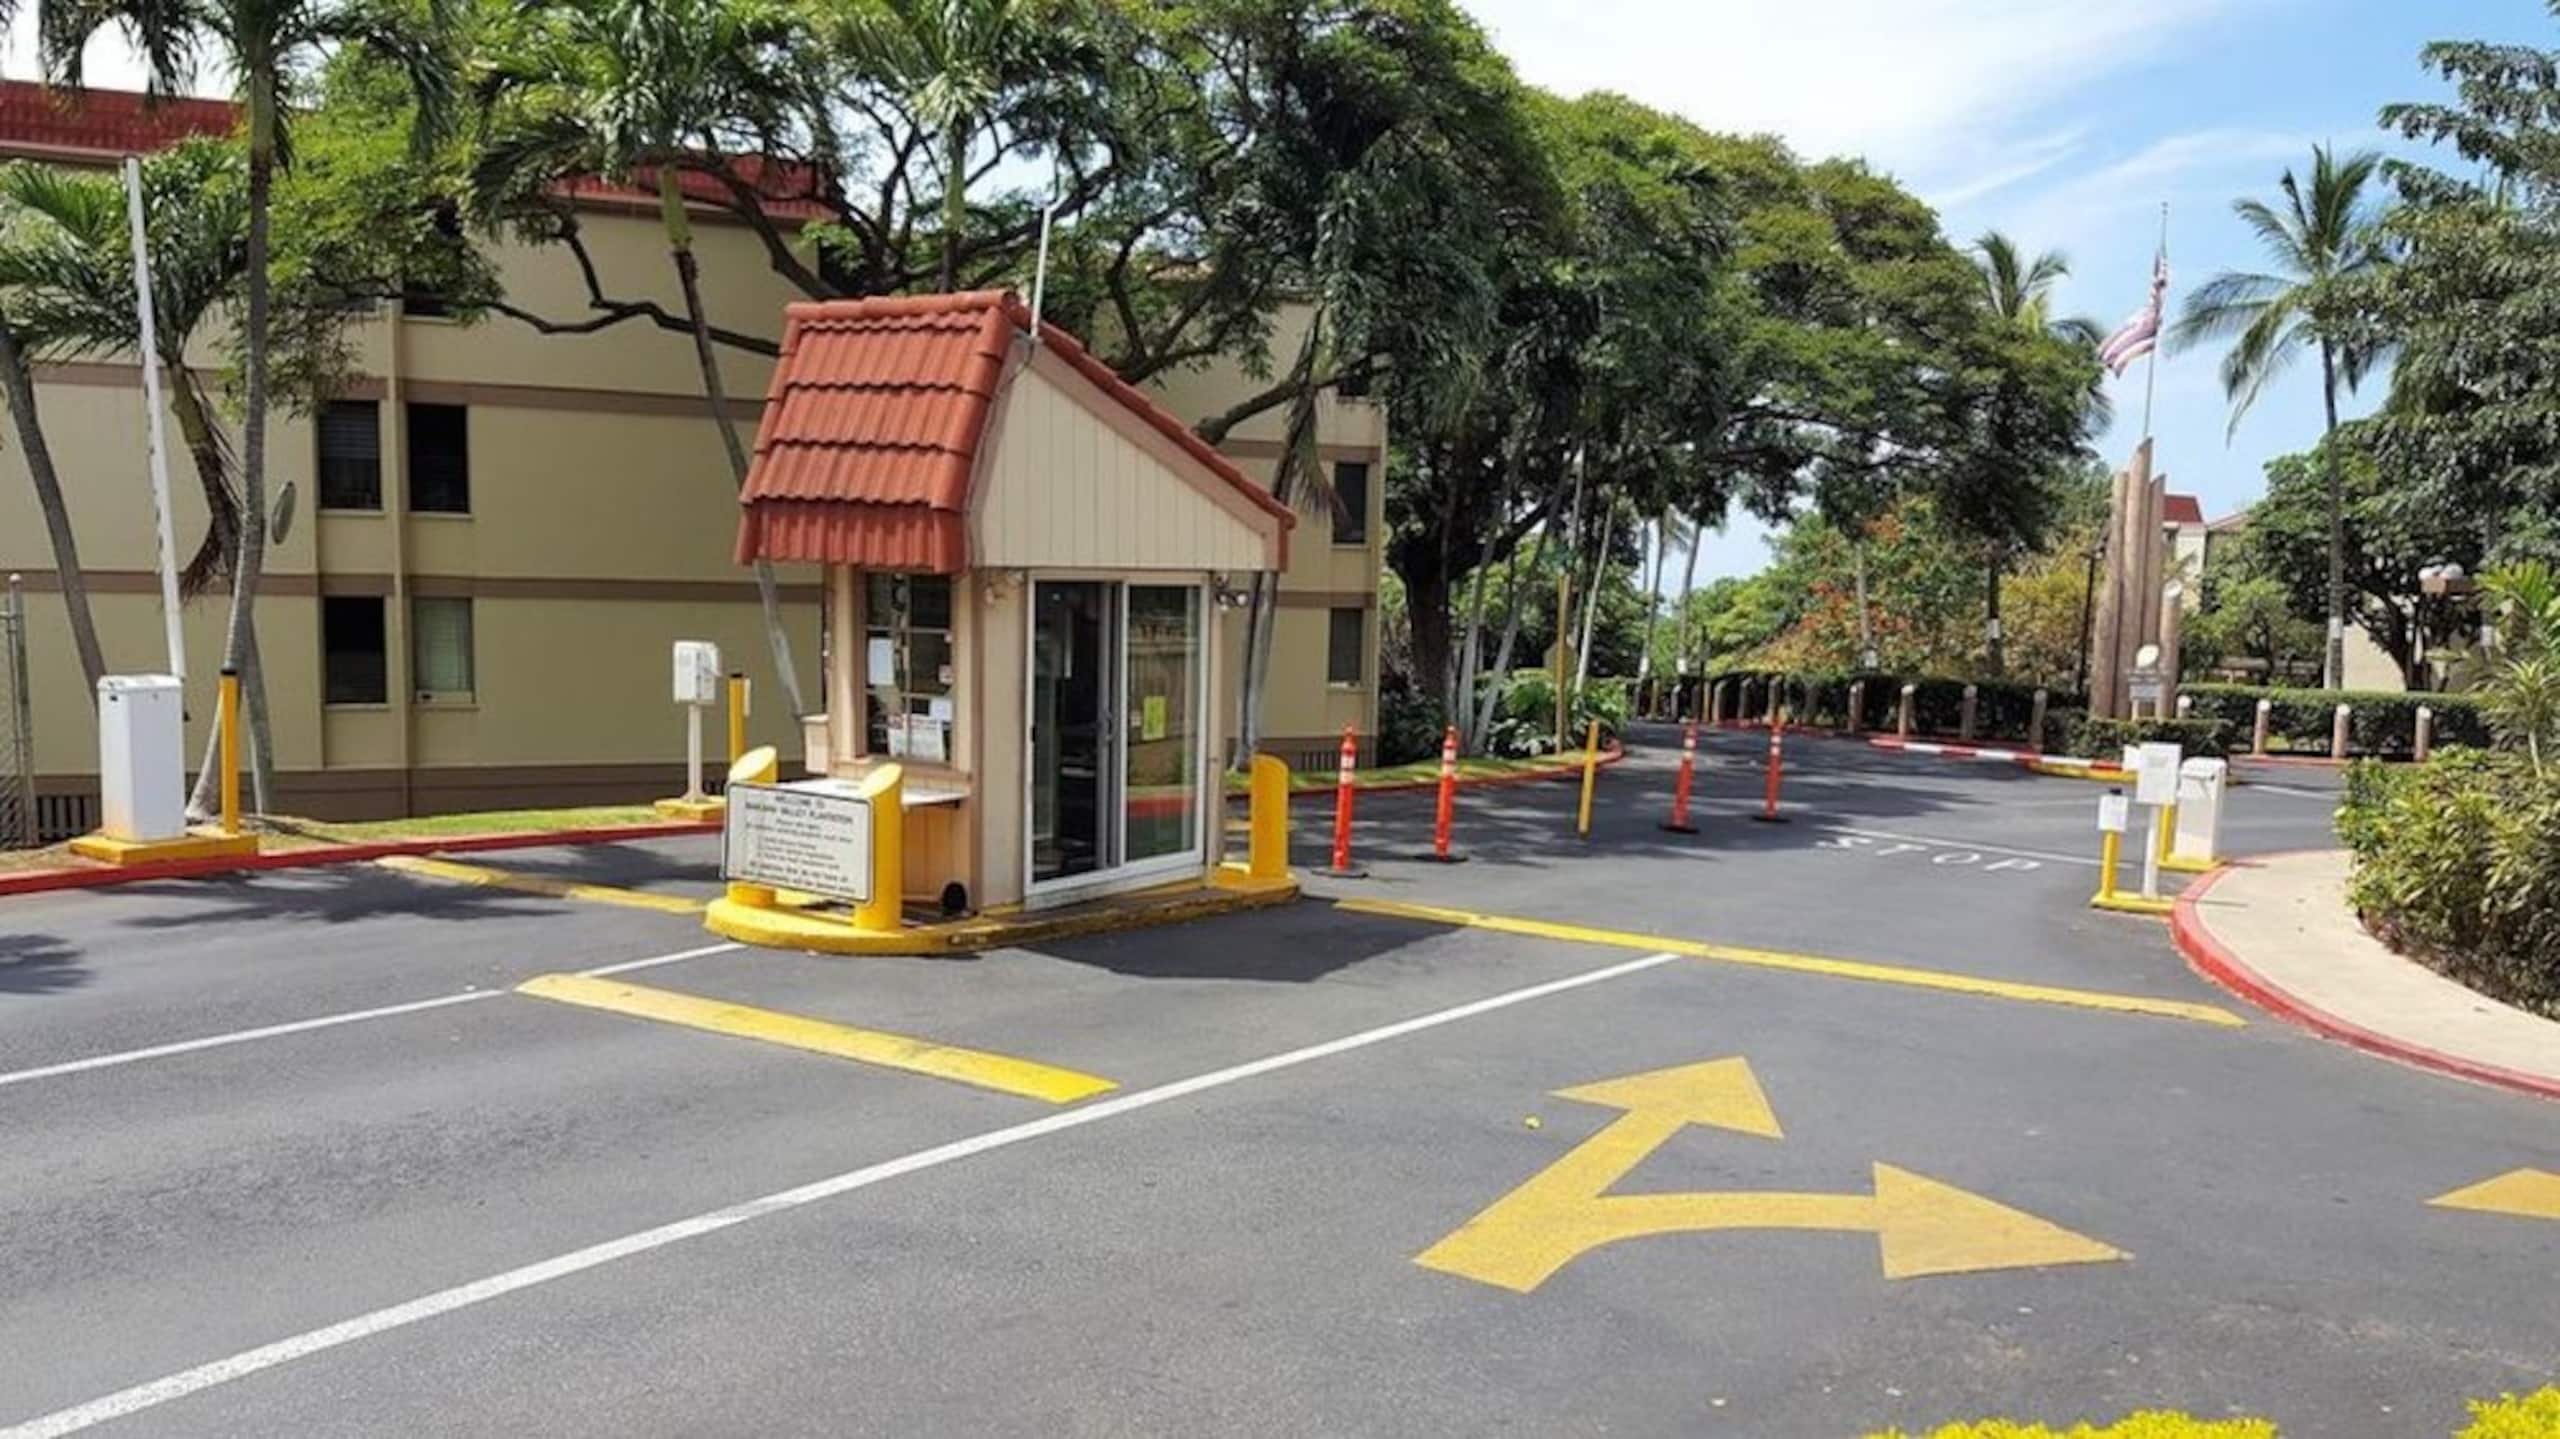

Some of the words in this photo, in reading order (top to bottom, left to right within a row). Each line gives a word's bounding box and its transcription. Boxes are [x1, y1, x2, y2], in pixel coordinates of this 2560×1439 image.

[816, 799, 826, 808] TO
[781, 807, 807, 817] VALLEY
[1816, 836, 2041, 871] STOP
